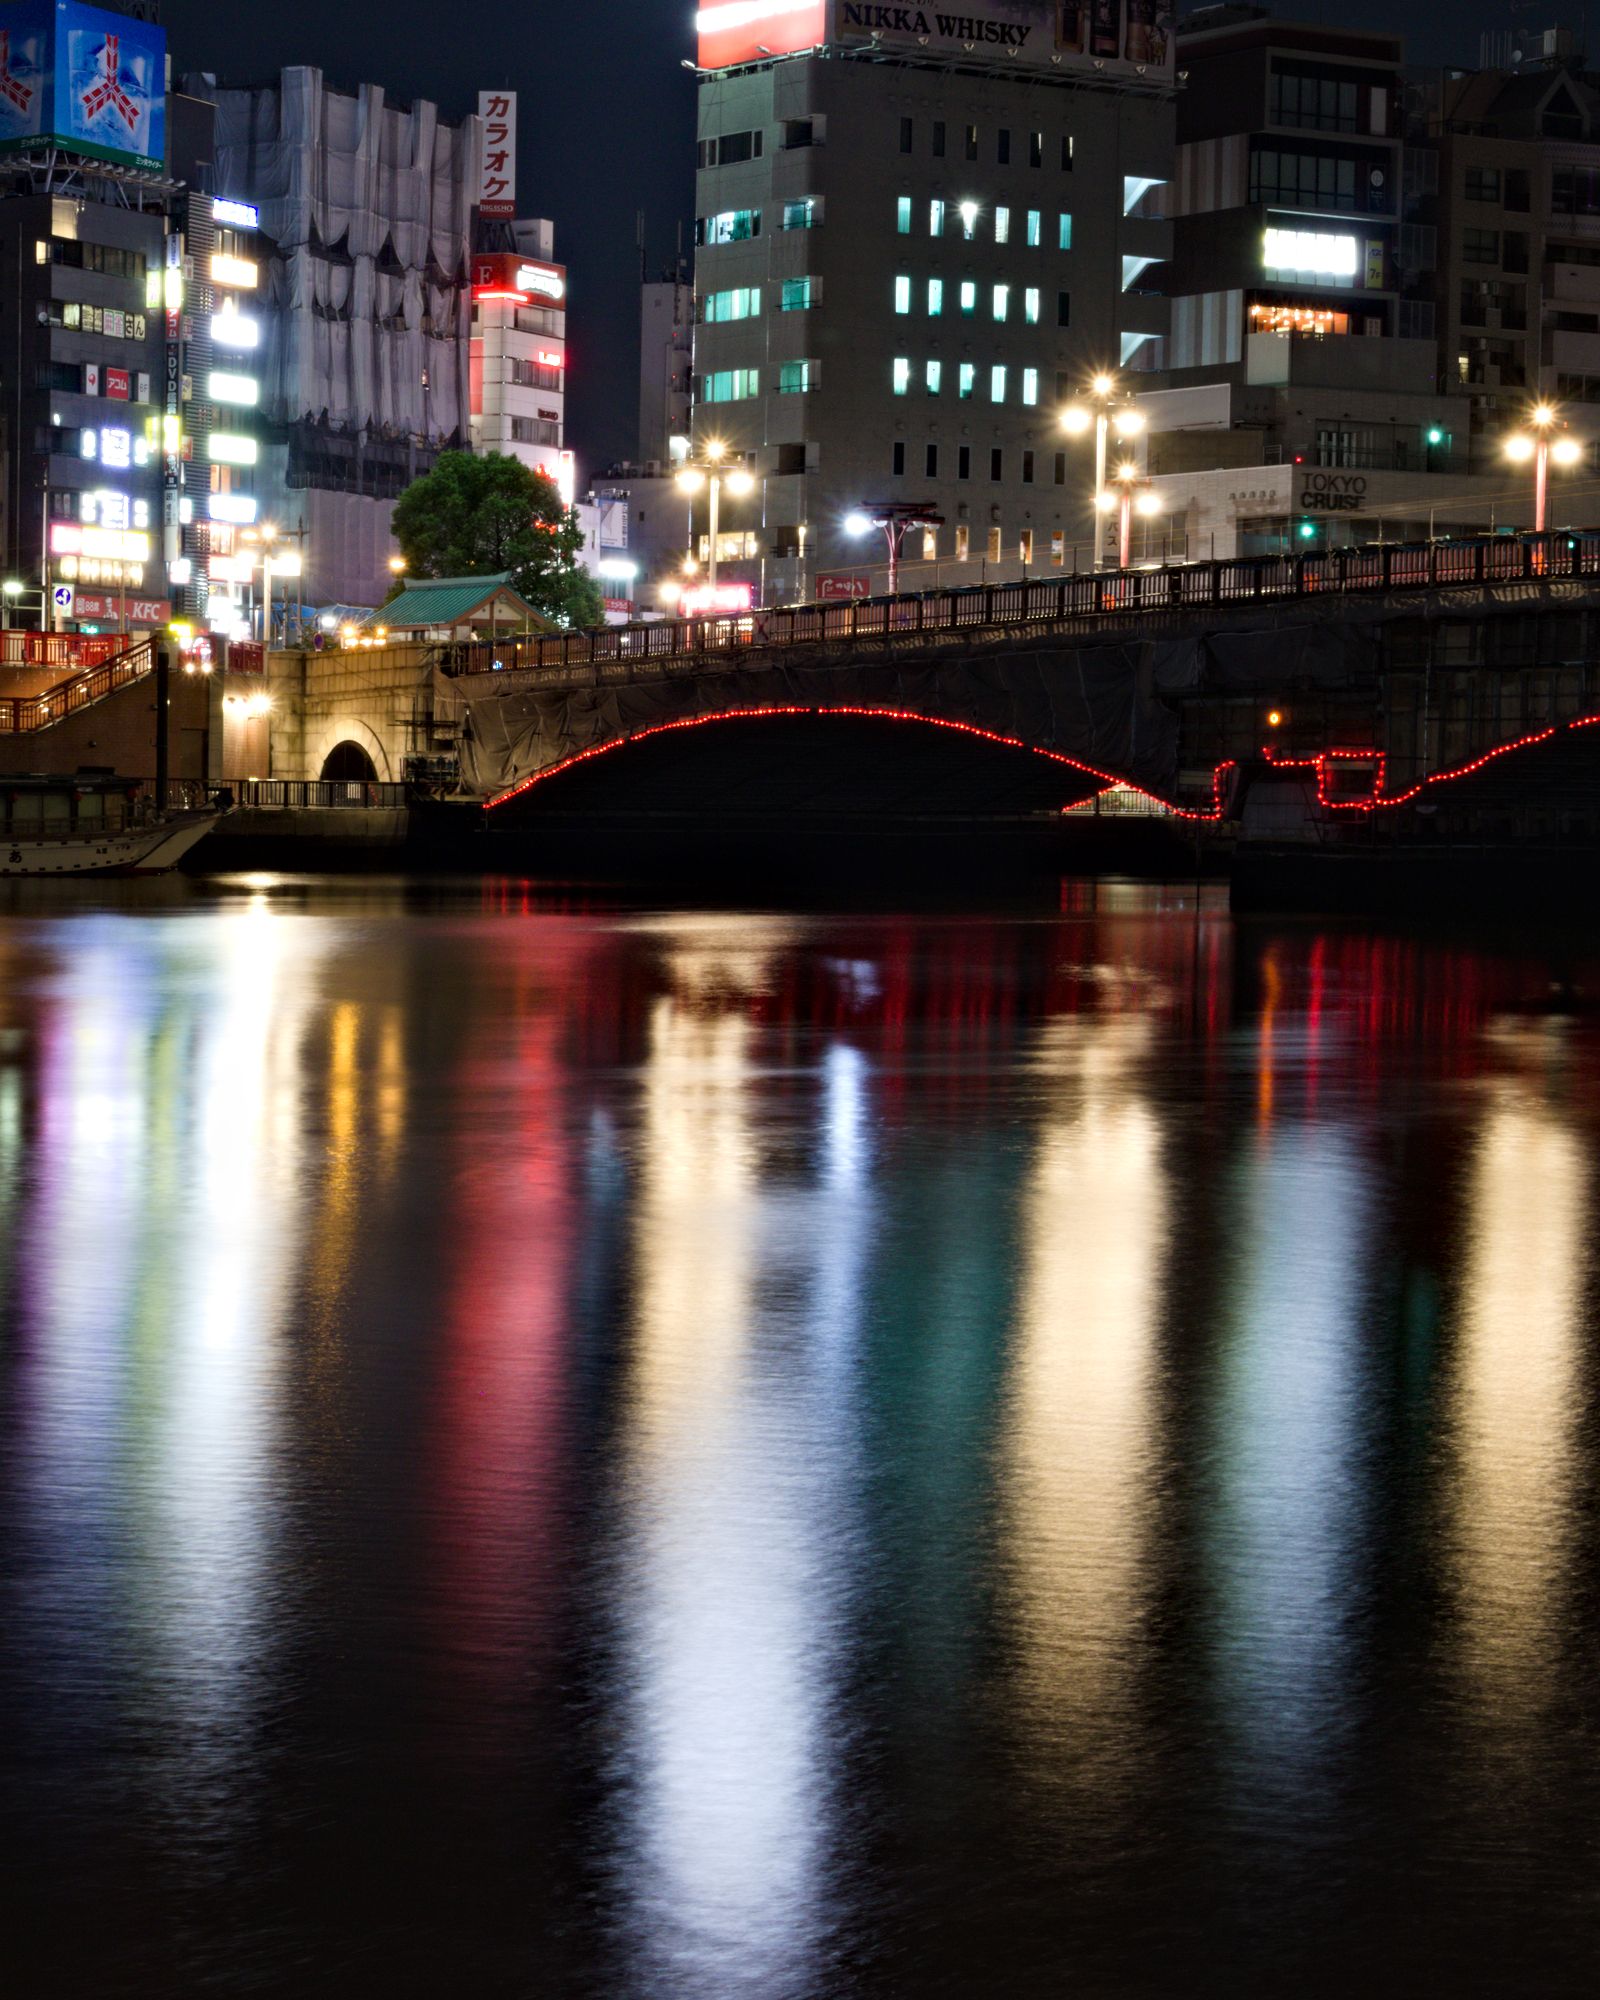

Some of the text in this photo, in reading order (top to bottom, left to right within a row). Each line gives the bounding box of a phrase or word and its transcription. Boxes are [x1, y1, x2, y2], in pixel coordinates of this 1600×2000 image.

[845, 3, 1031, 46] NIKKA WHISKY
[484, 96, 509, 198] カラオケ
[108, 378, 127, 391] アコム
[1302, 472, 1367, 494] TOKYO
[1301, 492, 1366, 512] CRUISE
[132, 602, 160, 620] KFC
[9, 850, 22, 863] あ
